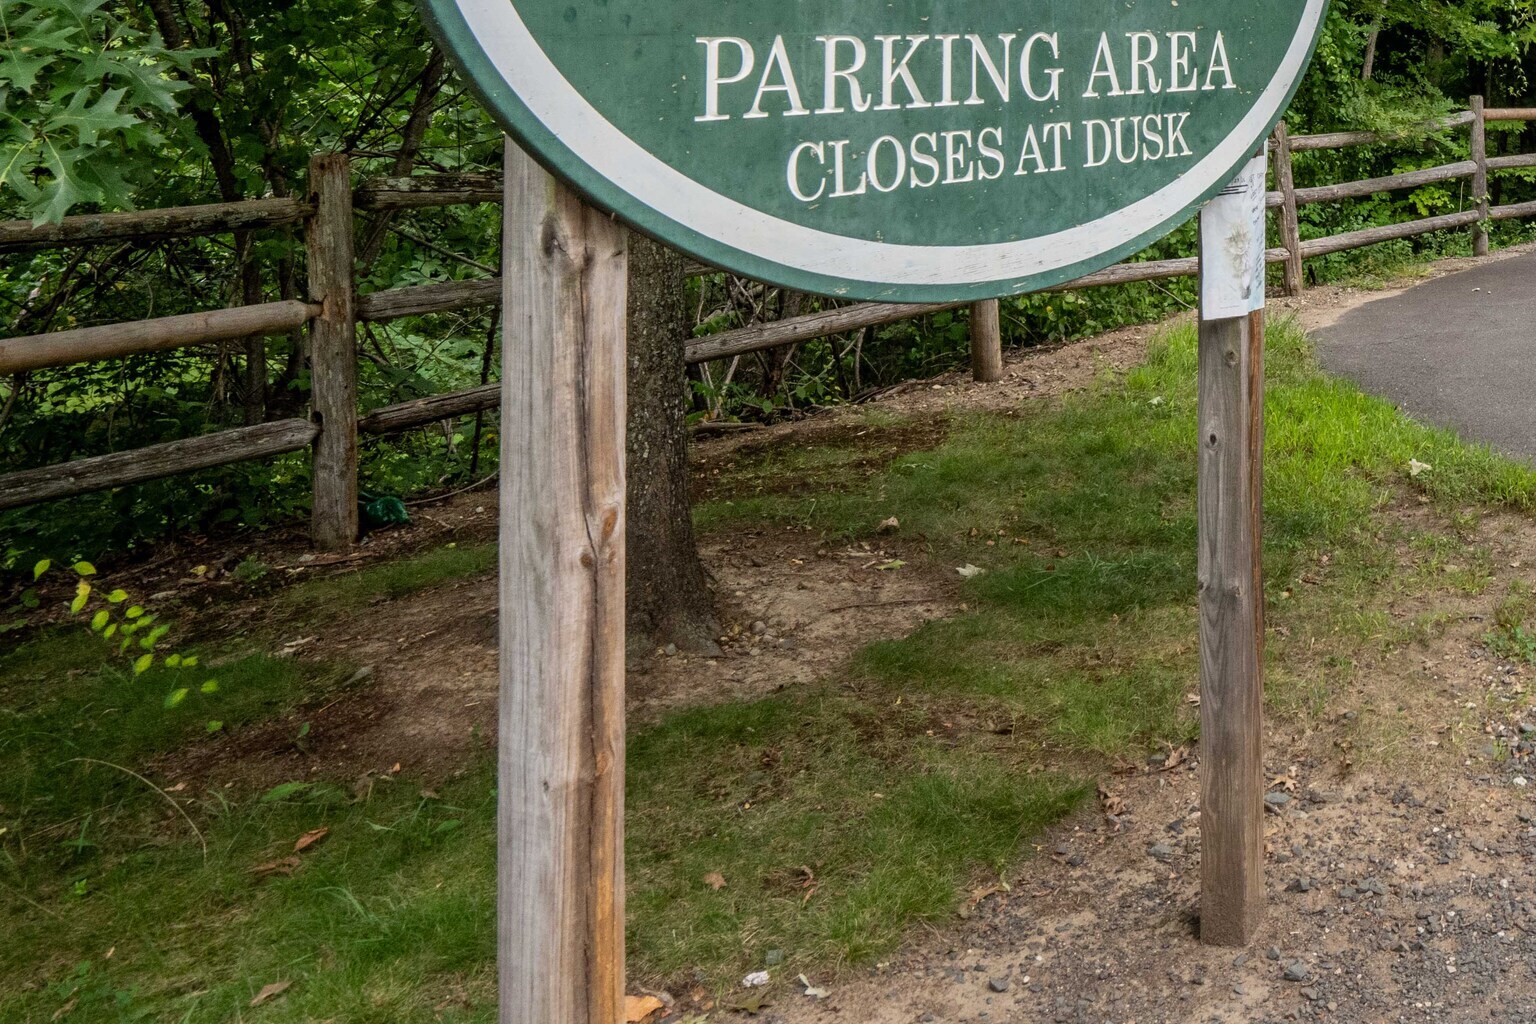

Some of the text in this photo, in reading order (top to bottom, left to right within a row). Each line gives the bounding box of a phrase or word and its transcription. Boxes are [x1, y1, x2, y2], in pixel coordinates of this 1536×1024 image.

[694, 29, 1237, 122] PARKING AREA
[786, 111, 1193, 202] CLOSES AT DUSK
